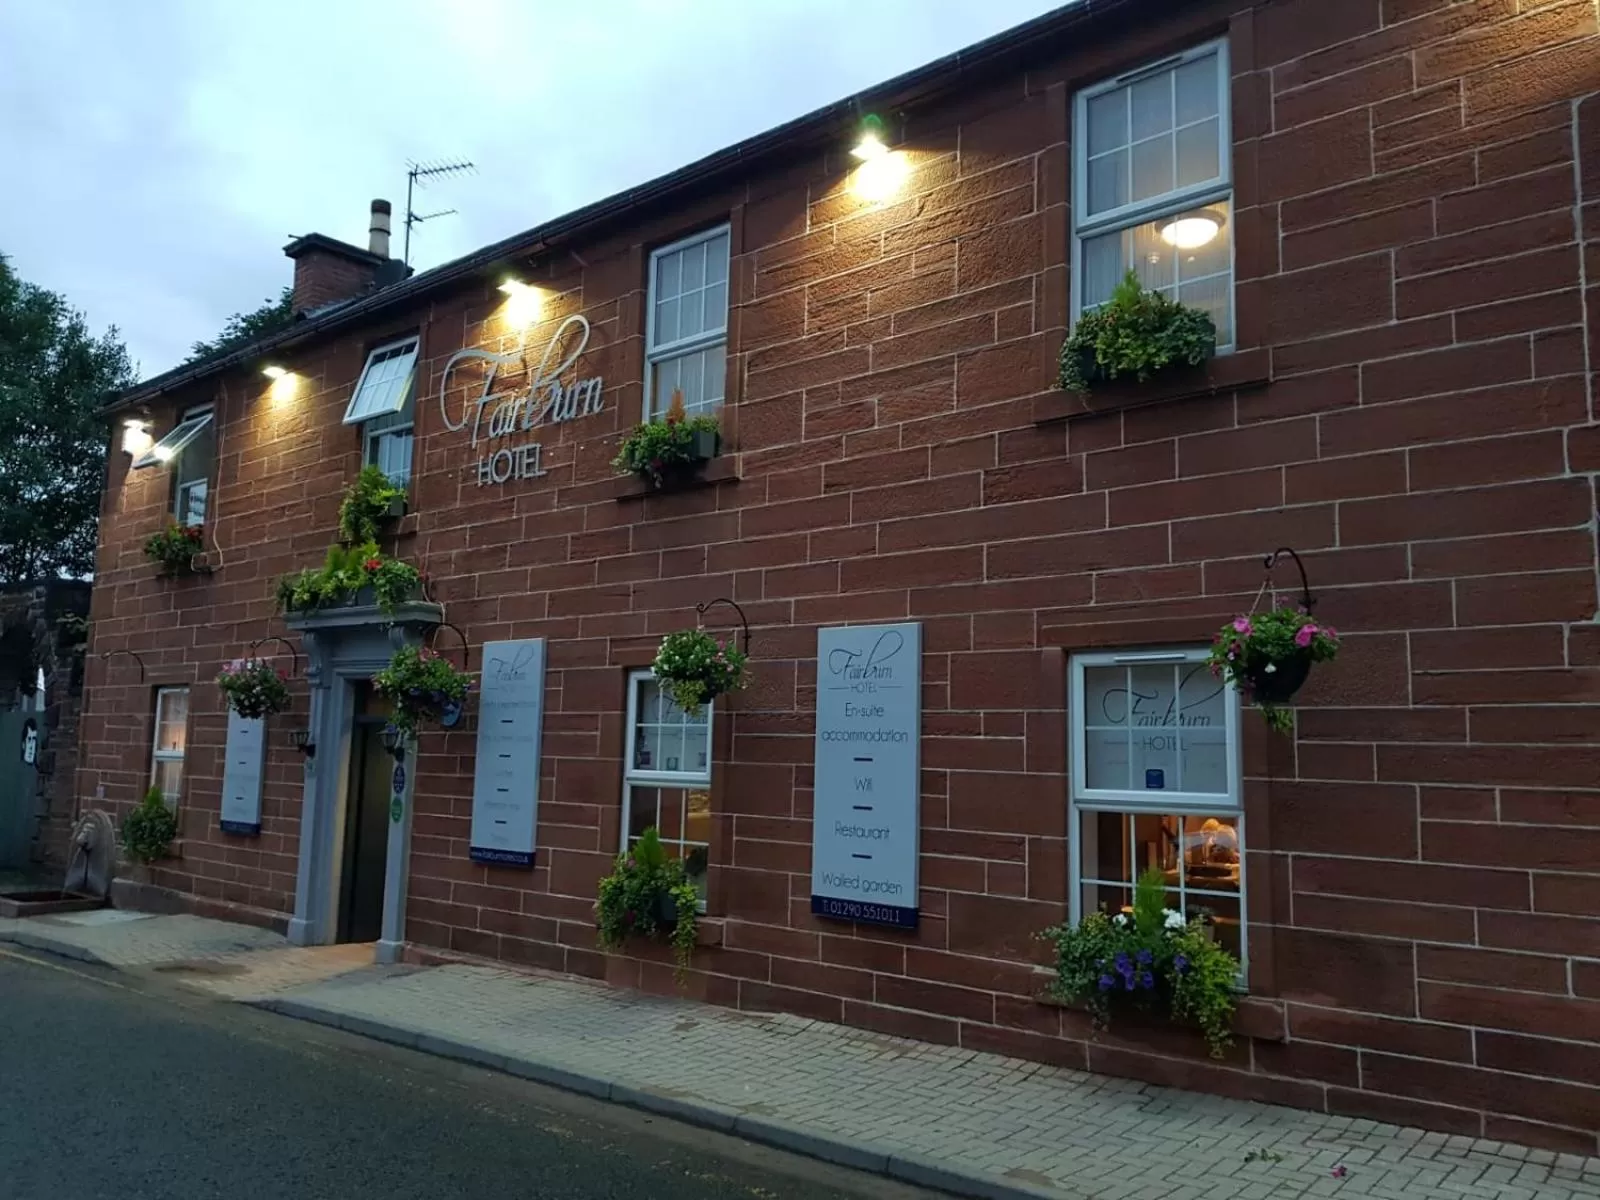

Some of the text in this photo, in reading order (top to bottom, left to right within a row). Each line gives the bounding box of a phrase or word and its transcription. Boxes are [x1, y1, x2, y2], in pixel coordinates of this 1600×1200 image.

[440, 315, 606, 449] Fairburn
[477, 443, 547, 487] HOTEL
[829, 630, 904, 680] Fairburn
[850, 683, 878, 694] HOTEL
[1102, 663, 1226, 728] Fairburn
[844, 702, 885, 718] En-suite
[821, 728, 908, 743] accommodation
[1142, 735, 1189, 752] HOTEL
[834, 821, 890, 840] Restaurant
[862, 878, 902, 896] garden
[830, 900, 862, 917] 01290
[863, 904, 900, 924] 551011
